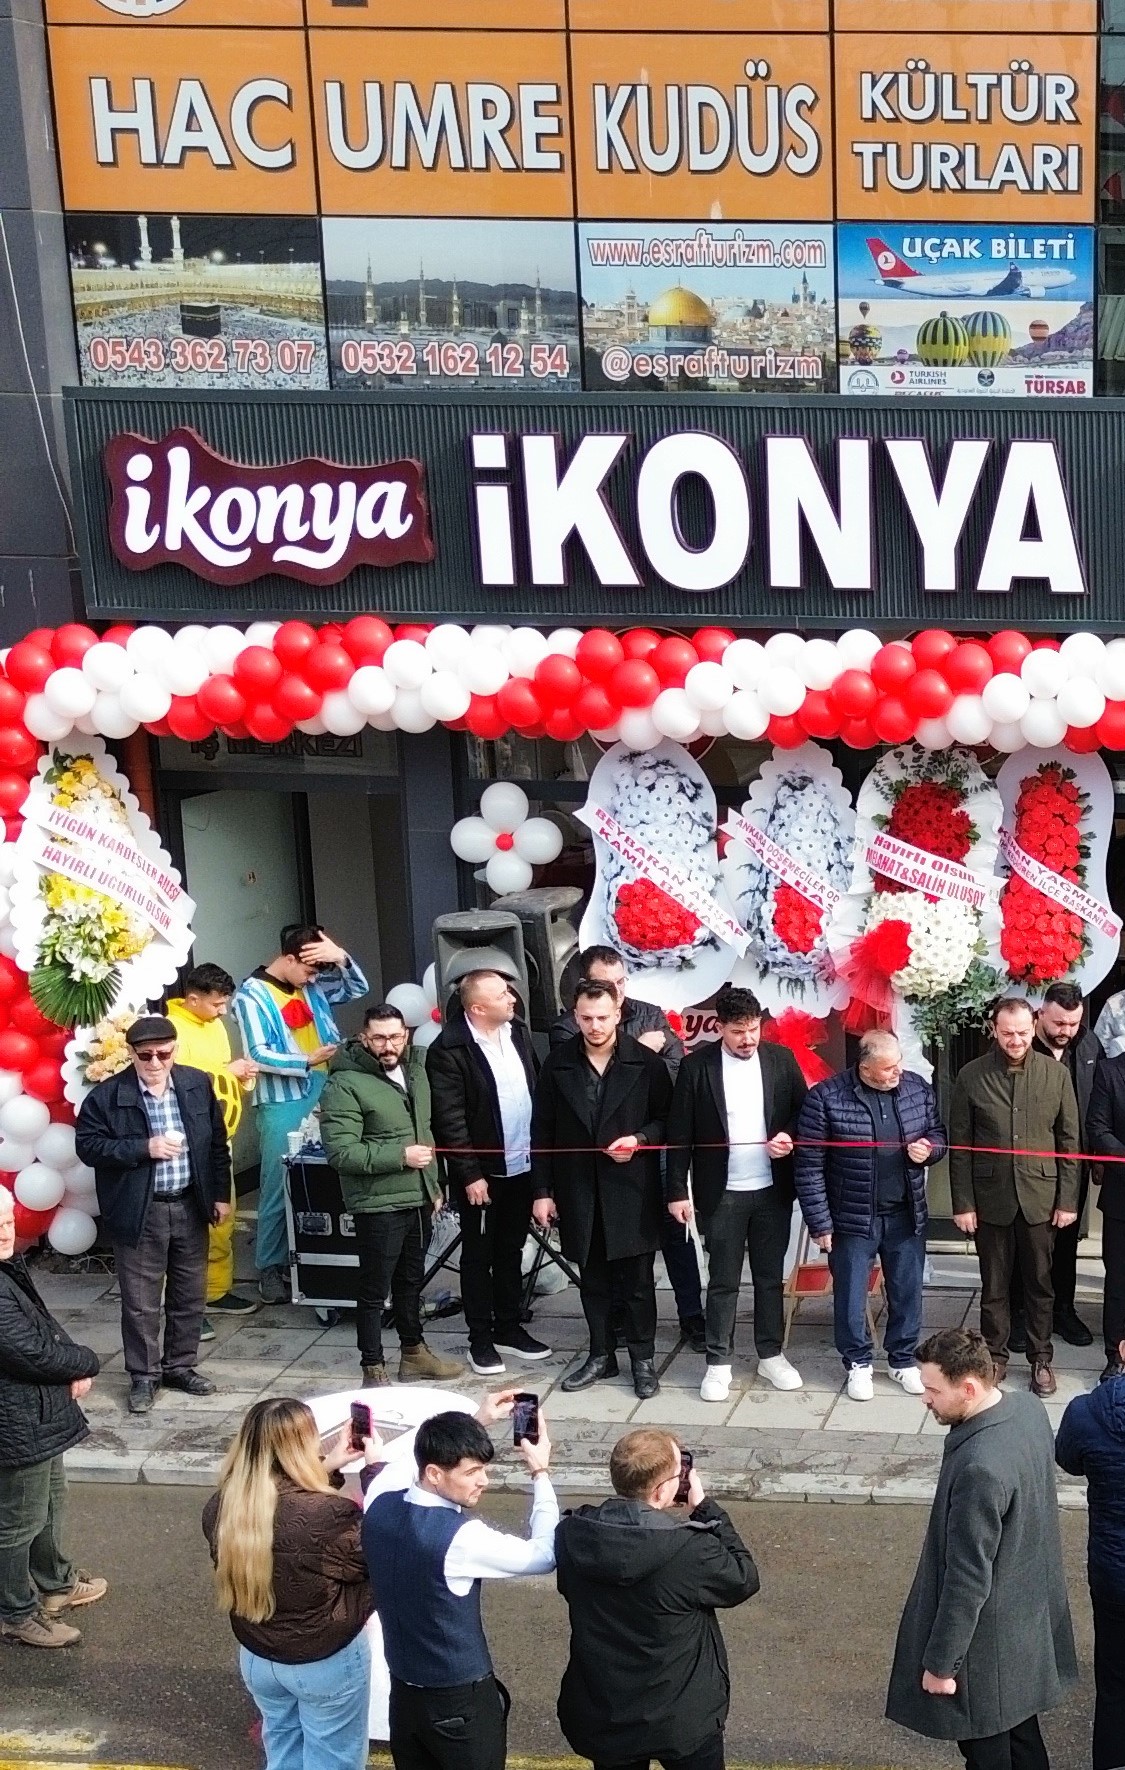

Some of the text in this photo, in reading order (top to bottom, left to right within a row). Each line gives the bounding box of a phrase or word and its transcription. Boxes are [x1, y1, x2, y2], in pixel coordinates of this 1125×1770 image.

[860, 58, 1079, 123] KÜLTÜR
[89, 59, 821, 176] HAC UMRE KUDÜS
[852, 141, 1081, 193] TURLARI
[587, 229, 827, 269] www.esrafturizm.com
[901, 233, 1077, 264] UÇAK BİLETİ
[90, 337, 315, 376] 0543 362 73 07
[340, 340, 570, 379] 0532 162 12 54
[601, 345, 823, 381] @esrafturizm
[909, 370, 947, 378] TURKISH
[908, 378, 947, 386] AIRLINES
[1024, 379, 1087, 395] TÜRSAB
[124, 446, 415, 569] ikonya
[595, 808, 686, 887] BEYBARAN
[735, 818, 766, 848] ANKARA
[873, 834, 927, 866] Hayırlı
[41, 846, 97, 880] HAYIRLI
[145, 899, 172, 931] OLSUN
[946, 881, 986, 908] ULUSOY
